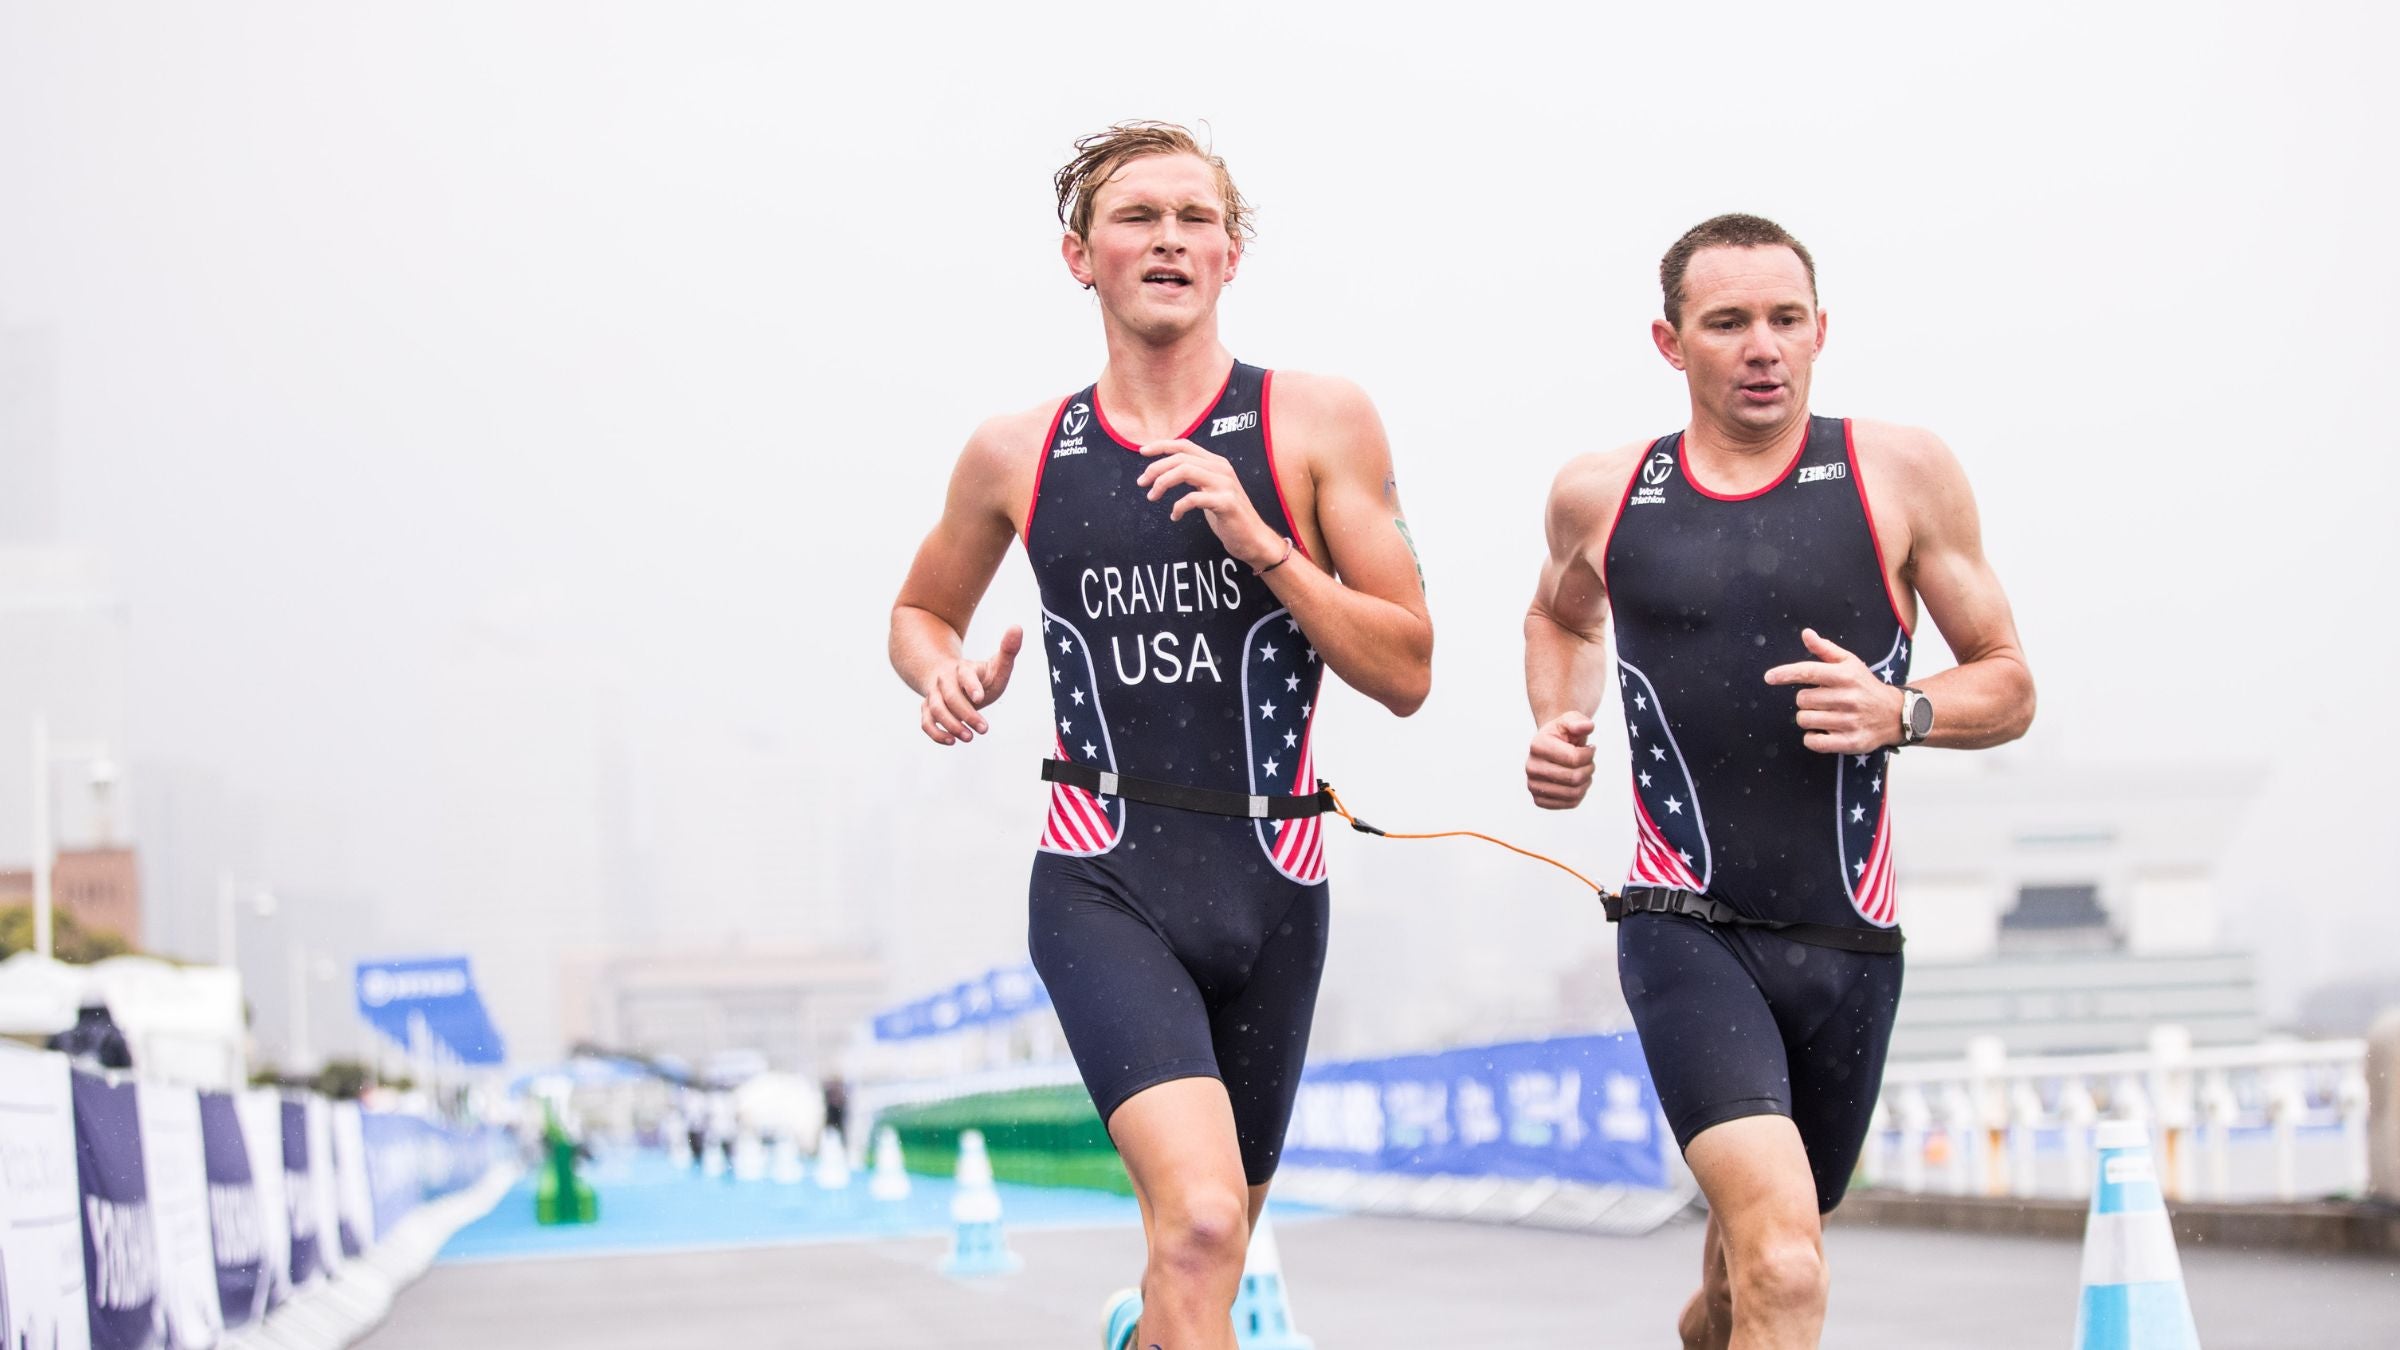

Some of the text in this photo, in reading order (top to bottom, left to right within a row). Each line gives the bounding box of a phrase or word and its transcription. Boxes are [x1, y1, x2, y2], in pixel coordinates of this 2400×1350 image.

[1060, 436, 1083, 448] World
[1053, 446, 1088, 458] Triathlon
[1639, 487, 1664, 495] World
[1631, 495, 1666, 506] Triathlon
[1081, 558, 1241, 619] CRAVENS
[1112, 631, 1222, 685] USA
